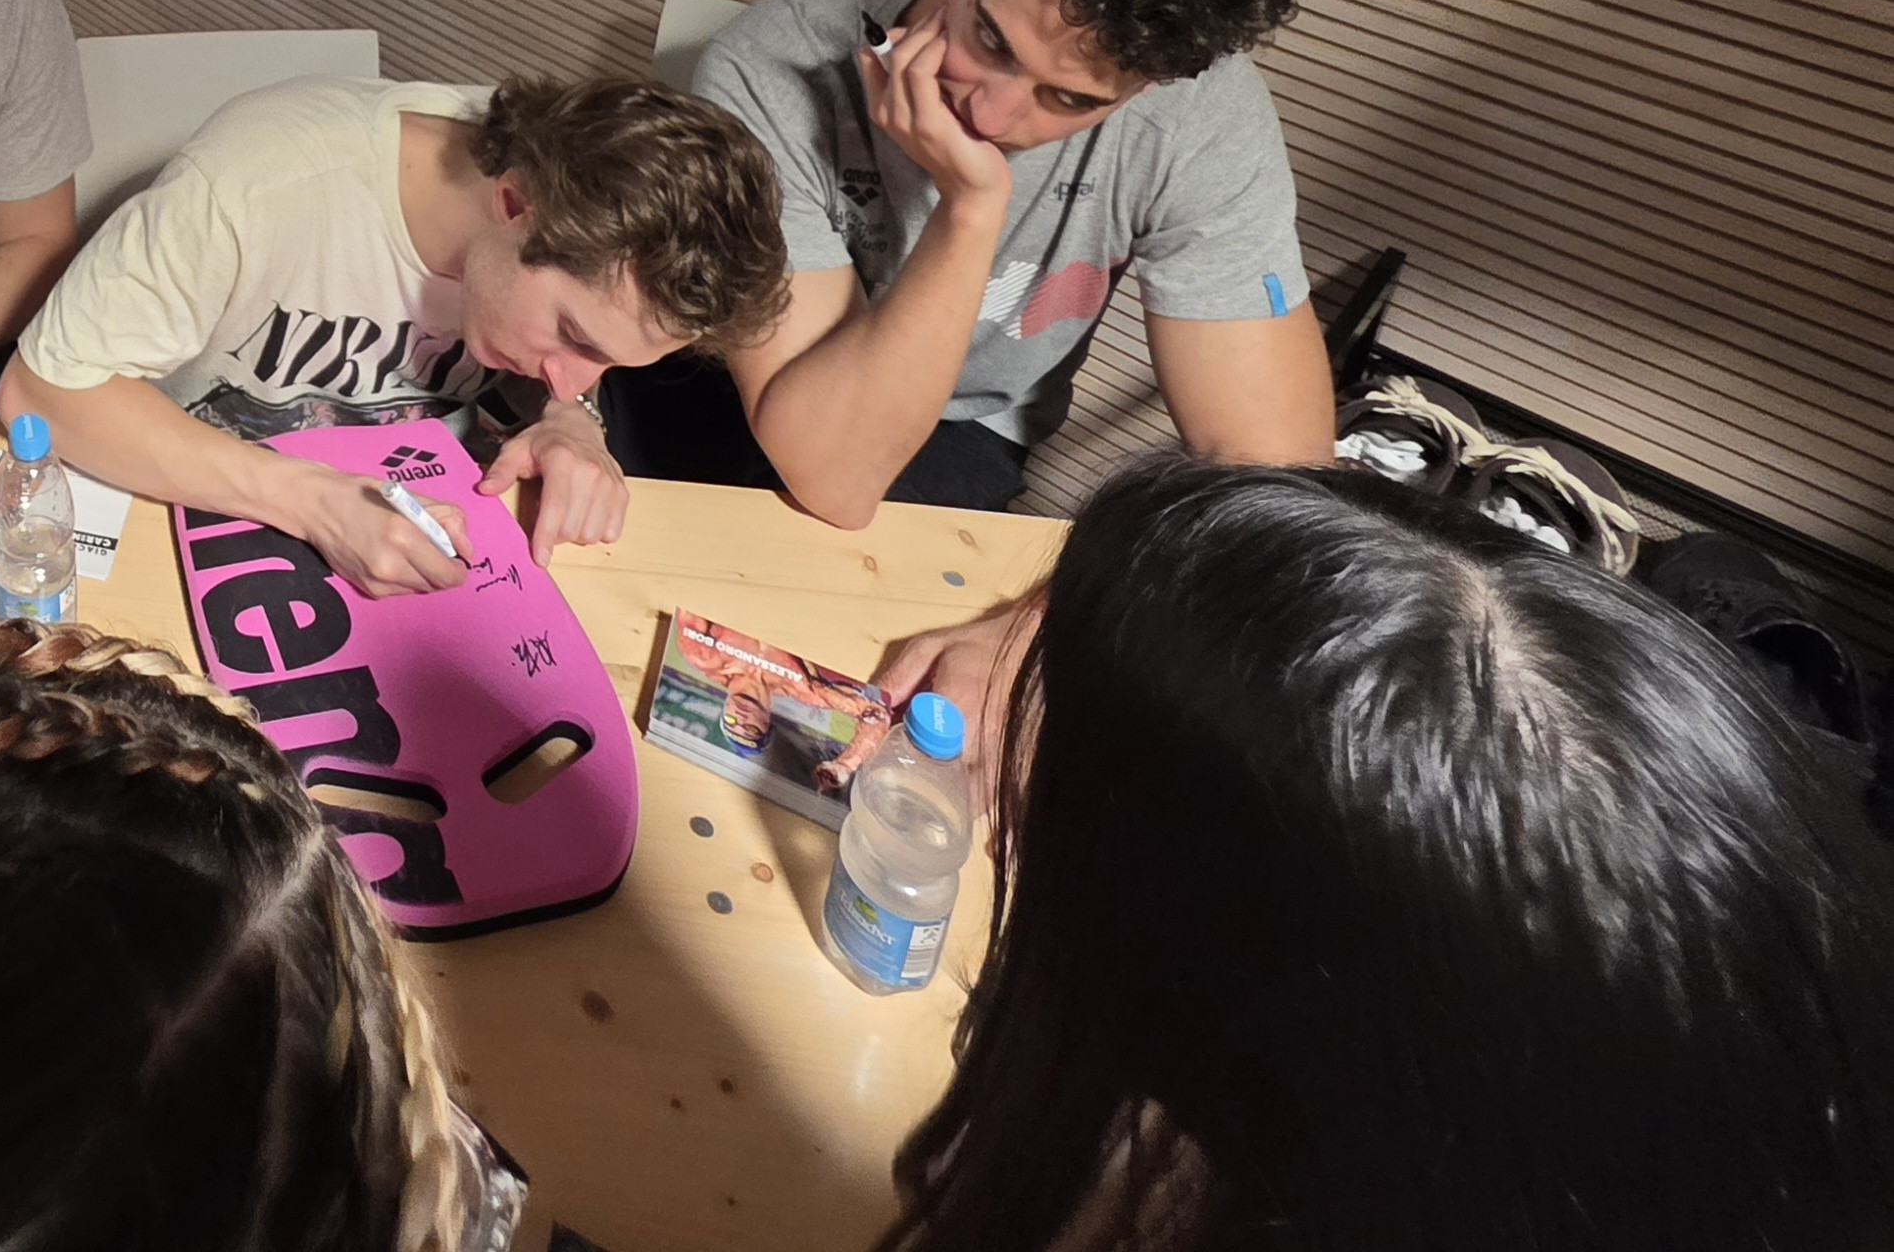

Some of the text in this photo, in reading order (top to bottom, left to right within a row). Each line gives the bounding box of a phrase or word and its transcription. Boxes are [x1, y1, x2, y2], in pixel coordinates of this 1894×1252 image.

[842, 167, 883, 187] arena
[386, 462, 447, 483] arena
[73, 543, 108, 557] GIAC
[683, 627, 804, 683] ALESSANDRO BORI
[183, 443, 465, 907] rena
